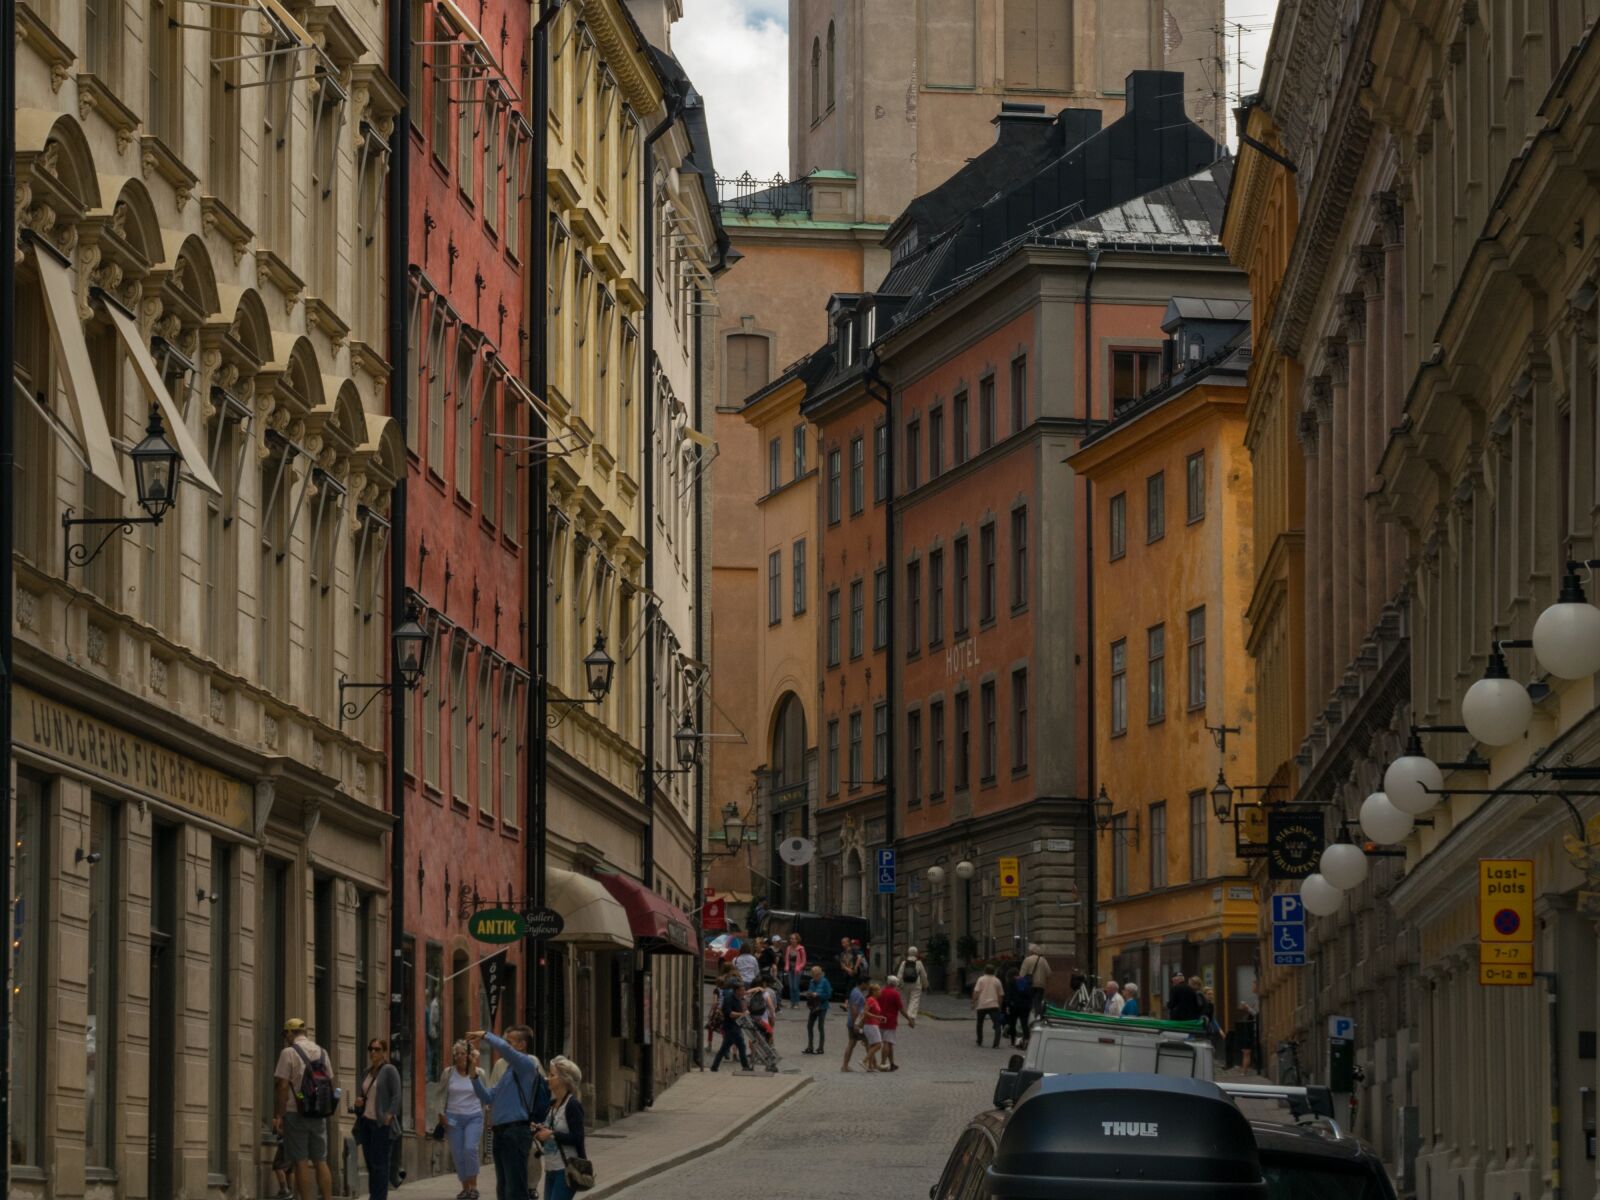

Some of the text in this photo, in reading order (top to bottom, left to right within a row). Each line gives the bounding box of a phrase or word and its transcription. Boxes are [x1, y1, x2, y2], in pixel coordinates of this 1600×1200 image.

[946, 636, 981, 677] HOTEL
[31, 699, 229, 817] LUNDGRENS FISKREDSKAP
[882, 851, 892, 865] P
[1487, 867, 1527, 879] Last-
[1488, 883, 1525, 896] plats
[1281, 897, 1297, 920] P
[526, 911, 554, 924] Galleri
[476, 919, 517, 935] ANTIK
[1494, 949, 1519, 958] 7-17
[1486, 970, 1528, 979] 0-12 m
[488, 961, 497, 1015] ÖPPET
[1336, 1020, 1350, 1036] P
[1101, 1121, 1158, 1137] THULE
